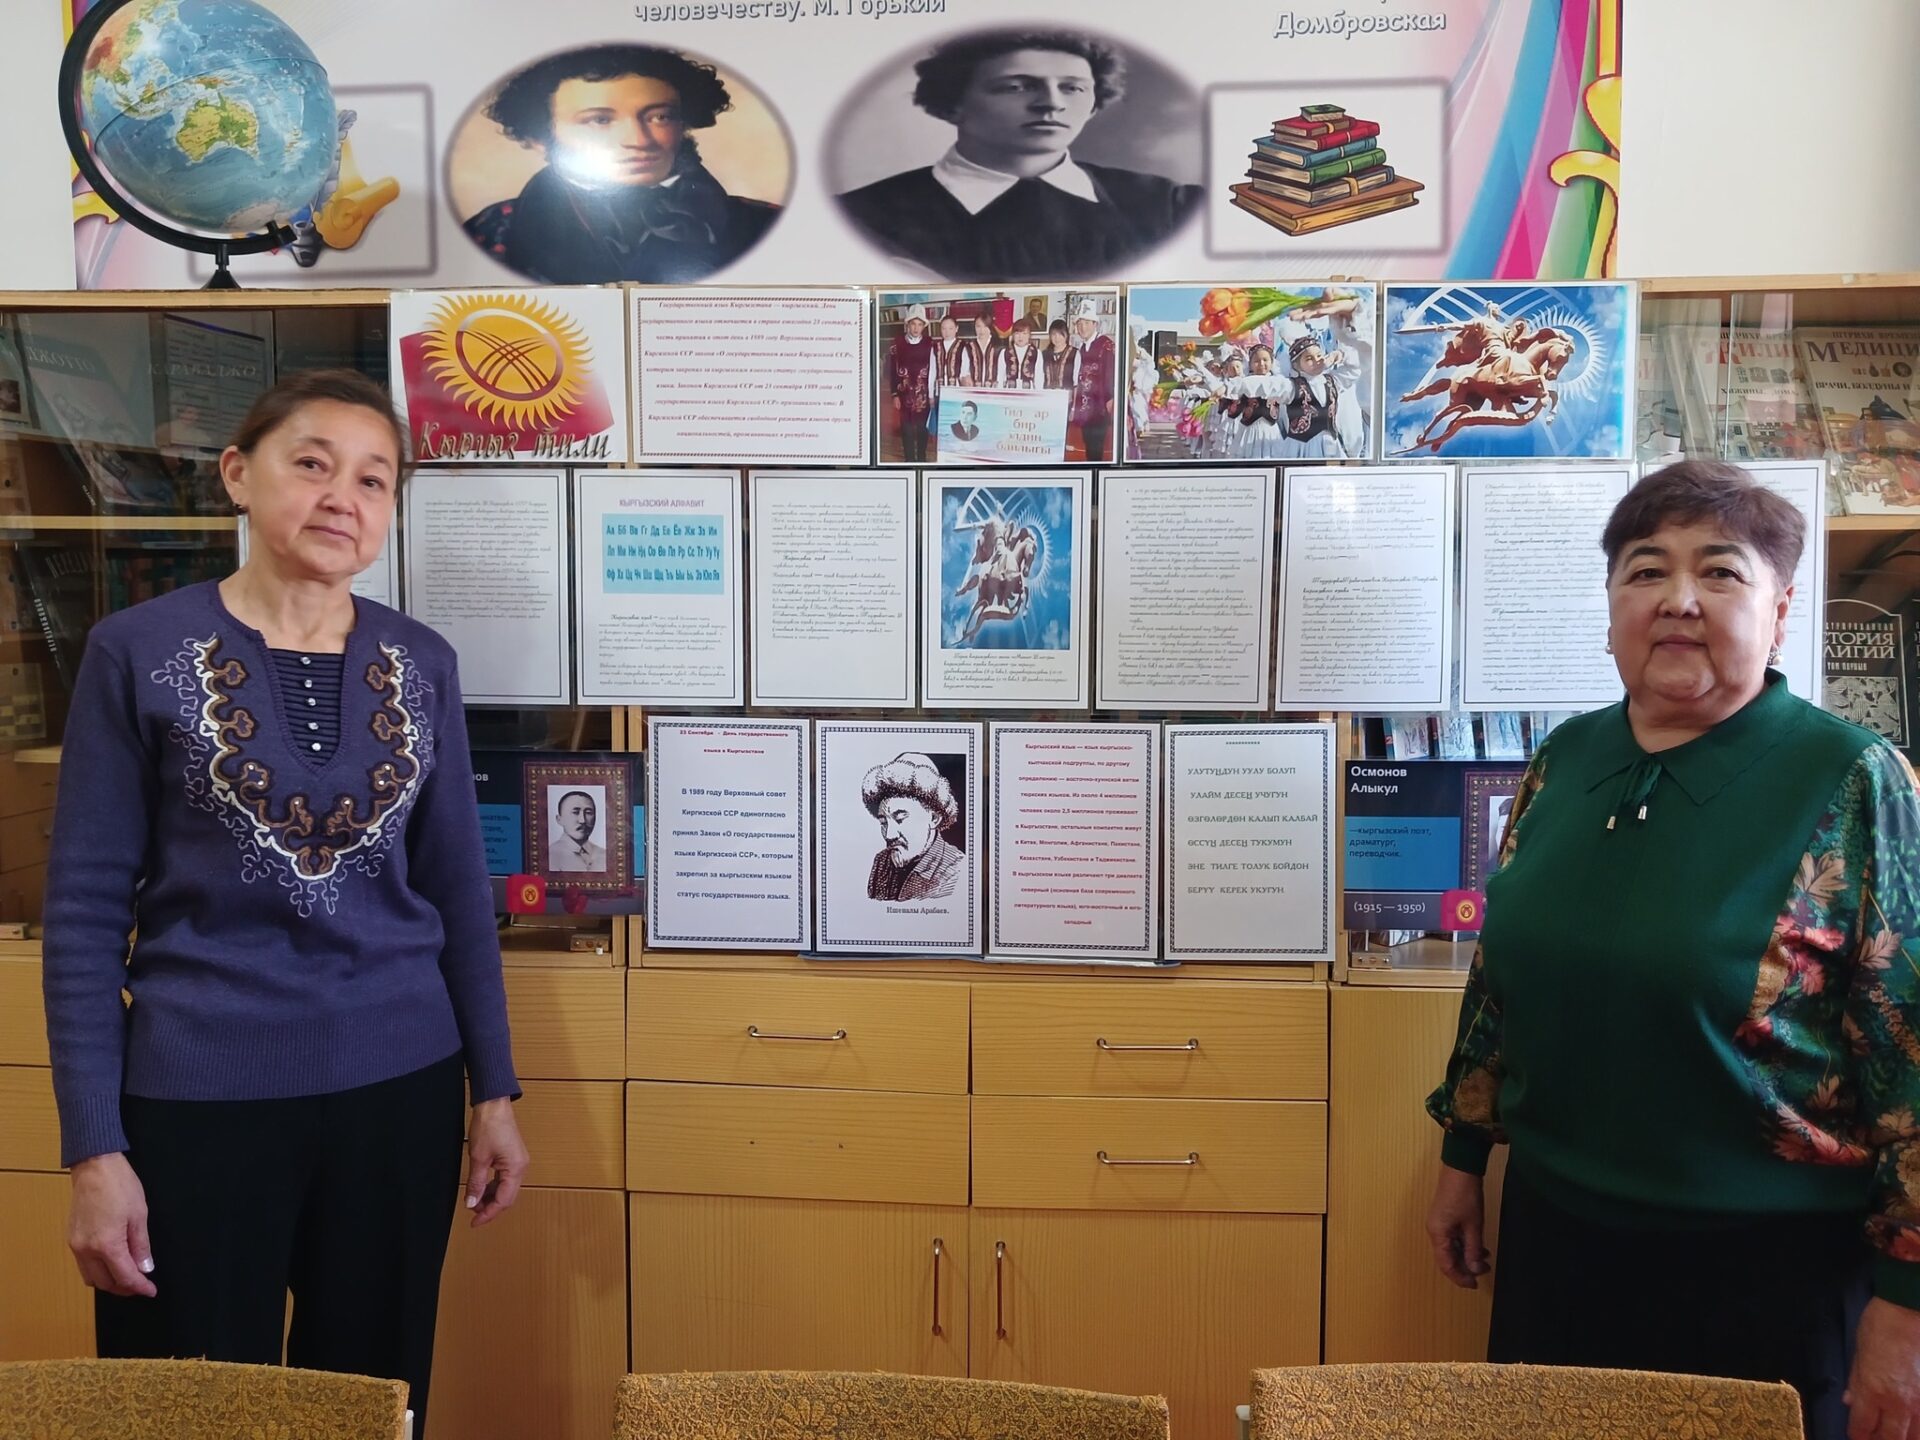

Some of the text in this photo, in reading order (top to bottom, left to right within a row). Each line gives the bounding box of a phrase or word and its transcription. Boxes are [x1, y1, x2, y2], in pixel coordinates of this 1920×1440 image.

[635, 0, 805, 22] человечеству.
[813, 0, 838, 16] М.
[1273, 10, 1446, 40] Домбровская
[1804, 341, 1920, 362] МЕДИЦИ
[619, 498, 704, 508] КЫРГЫЗСКИЙ АЛФАВИТ
[1823, 632, 1895, 645] СТОРИЯ
[1824, 645, 1895, 658] ЛИГИЙ
[1351, 766, 1407, 777] Осмонов
[706, 790, 722, 798] году
[724, 789, 764, 798] Верховный
[1351, 783, 1398, 795] Алыкул
[682, 809, 722, 817] Киргизской
[734, 832, 796, 840] государственном
[1349, 840, 1396, 848] драматург,
[697, 850, 737, 859] Киргизской
[1273, 862, 1309, 870] БОЙДОН
[701, 892, 765, 901] государственного
[1354, 902, 1382, 913] (1915
[1397, 902, 1425, 913] 1950)
